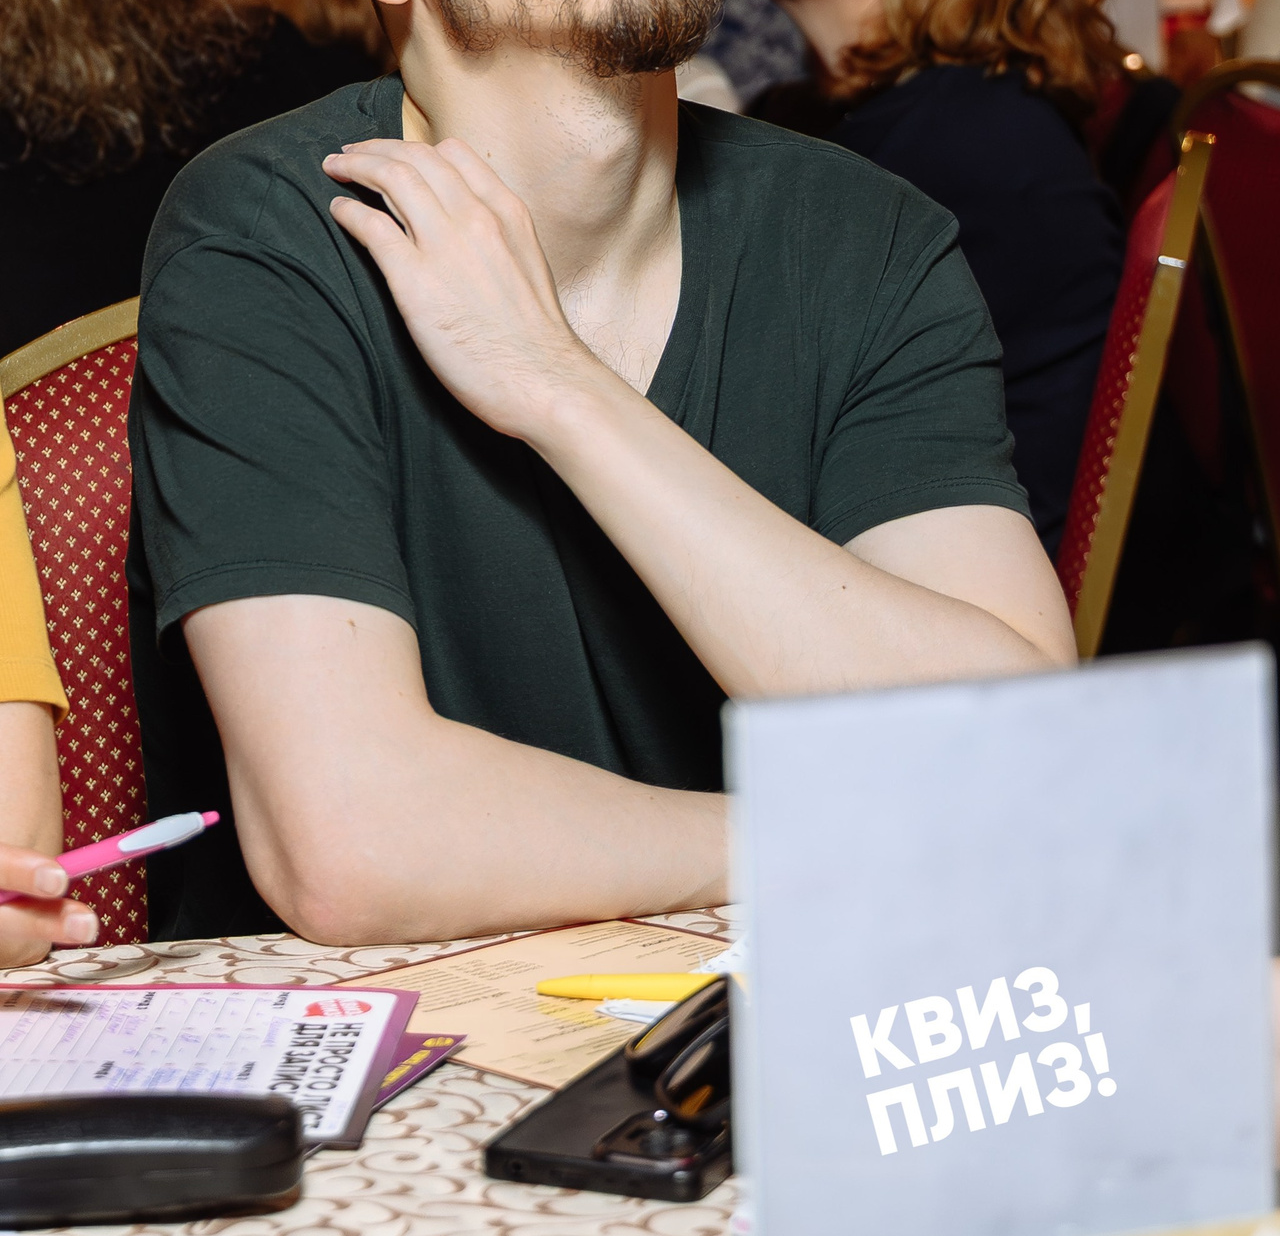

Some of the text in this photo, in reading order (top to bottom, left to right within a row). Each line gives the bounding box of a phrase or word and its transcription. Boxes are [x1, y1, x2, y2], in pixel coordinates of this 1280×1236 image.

[290, 1022, 327, 1047] ДЛЯ
[330, 1022, 364, 1037] НЕ
[268, 1050, 316, 1094] ЗАПИС
[307, 1041, 356, 1091] ПРОСТО
